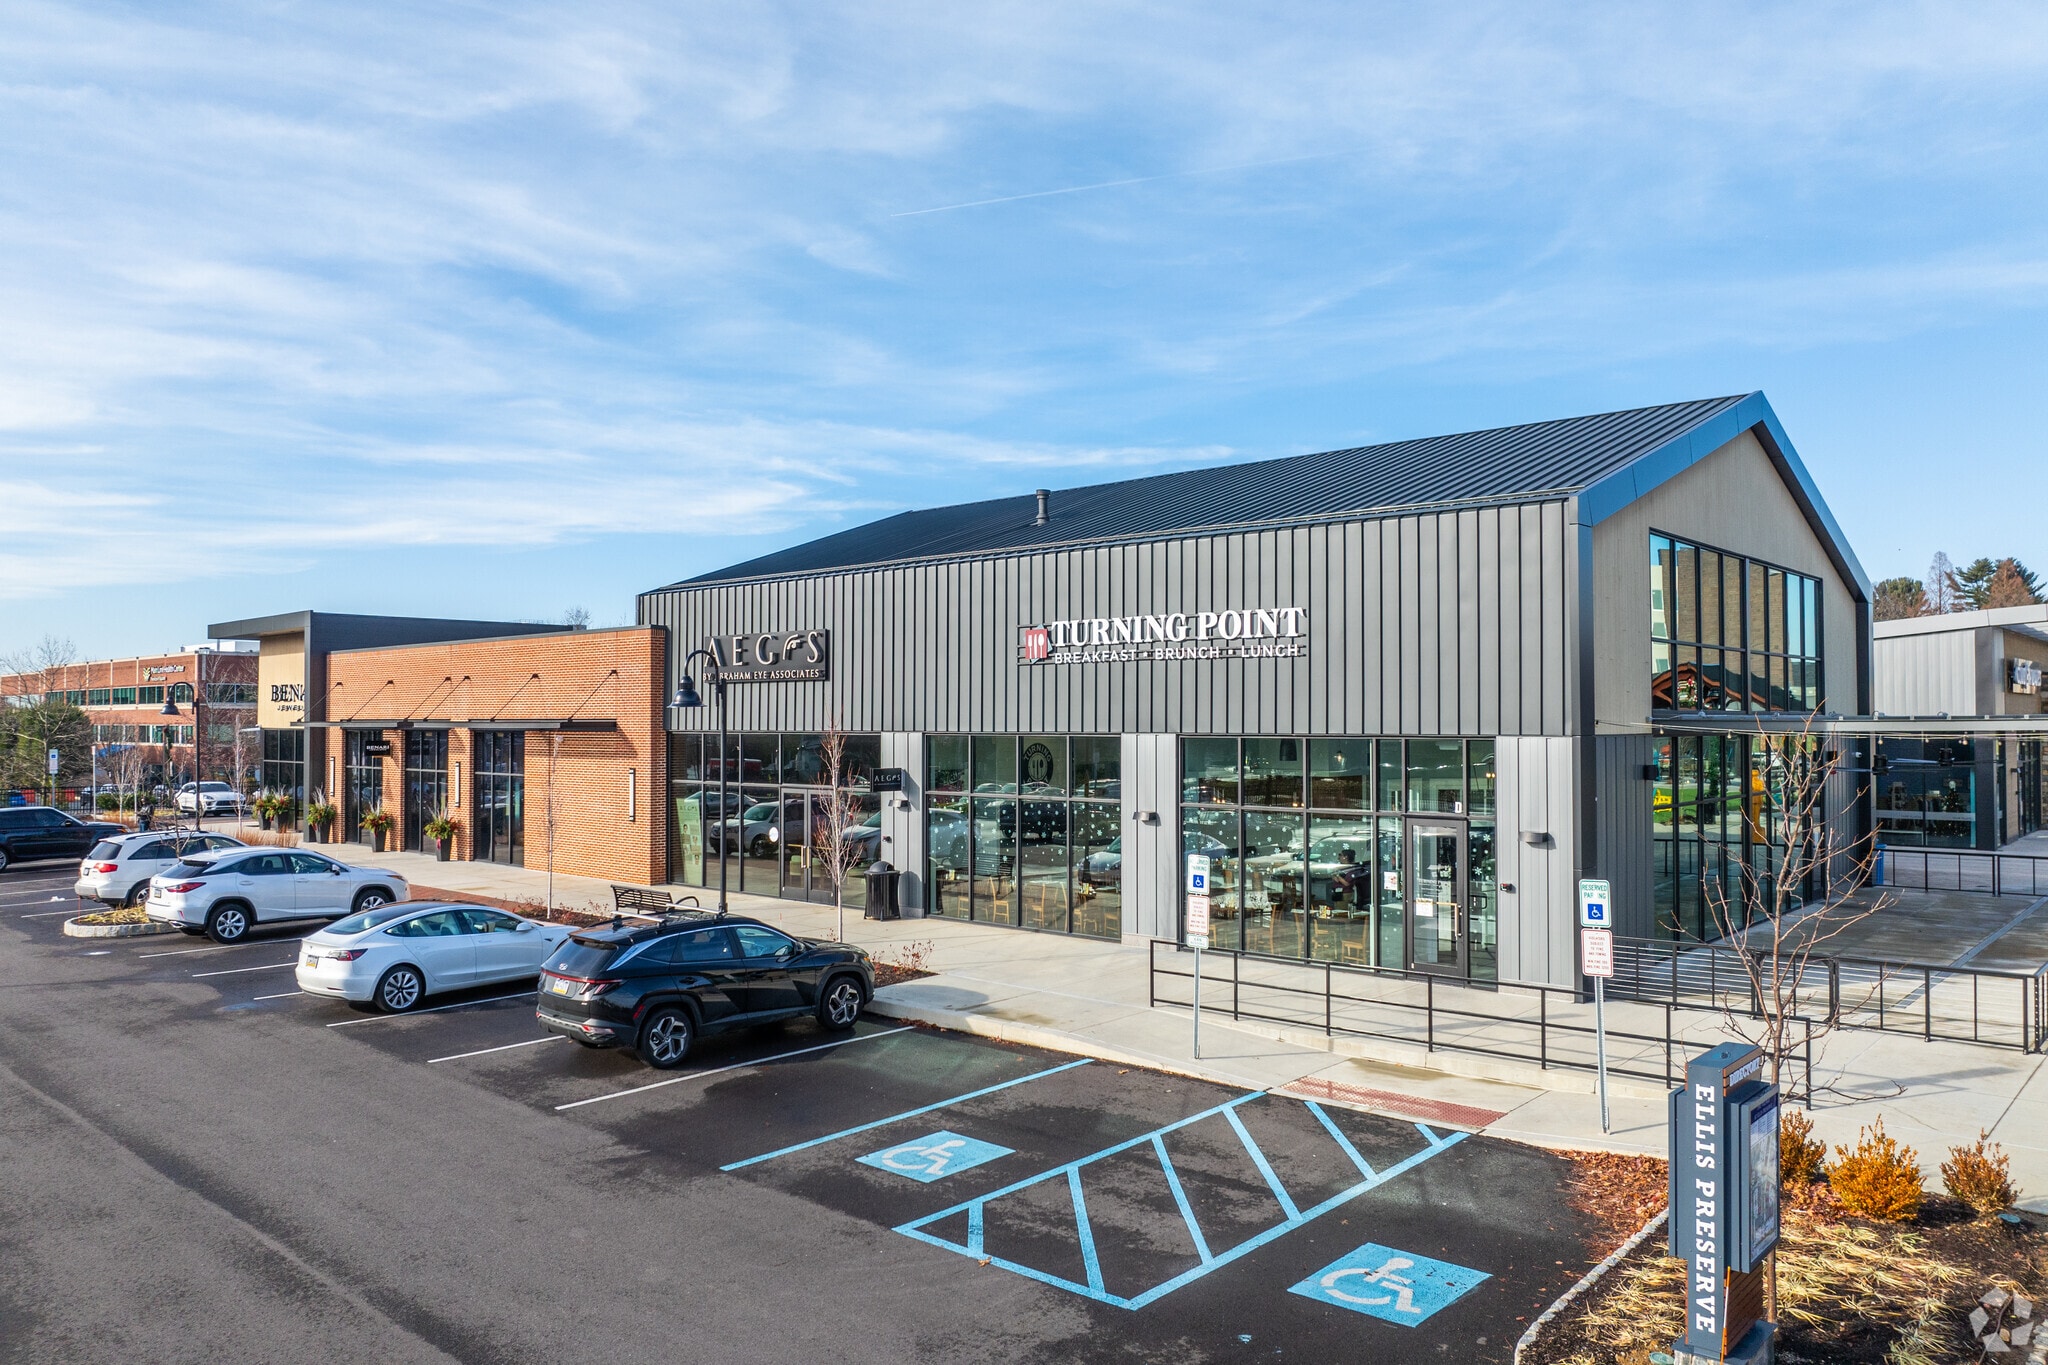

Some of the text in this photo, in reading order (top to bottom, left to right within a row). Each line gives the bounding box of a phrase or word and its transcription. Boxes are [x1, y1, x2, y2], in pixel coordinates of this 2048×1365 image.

[1051, 607, 1304, 647] TURNING POINT
[1054, 644, 1298, 664] BREAKFAST BRUNCH LUNCH
[702, 669, 820, 681] BY BRAHAM EYE ASSOCIATES
[1024, 744, 1052, 762] TURNING
[1695, 1083, 1716, 1334] ELLIS PRESERVE
